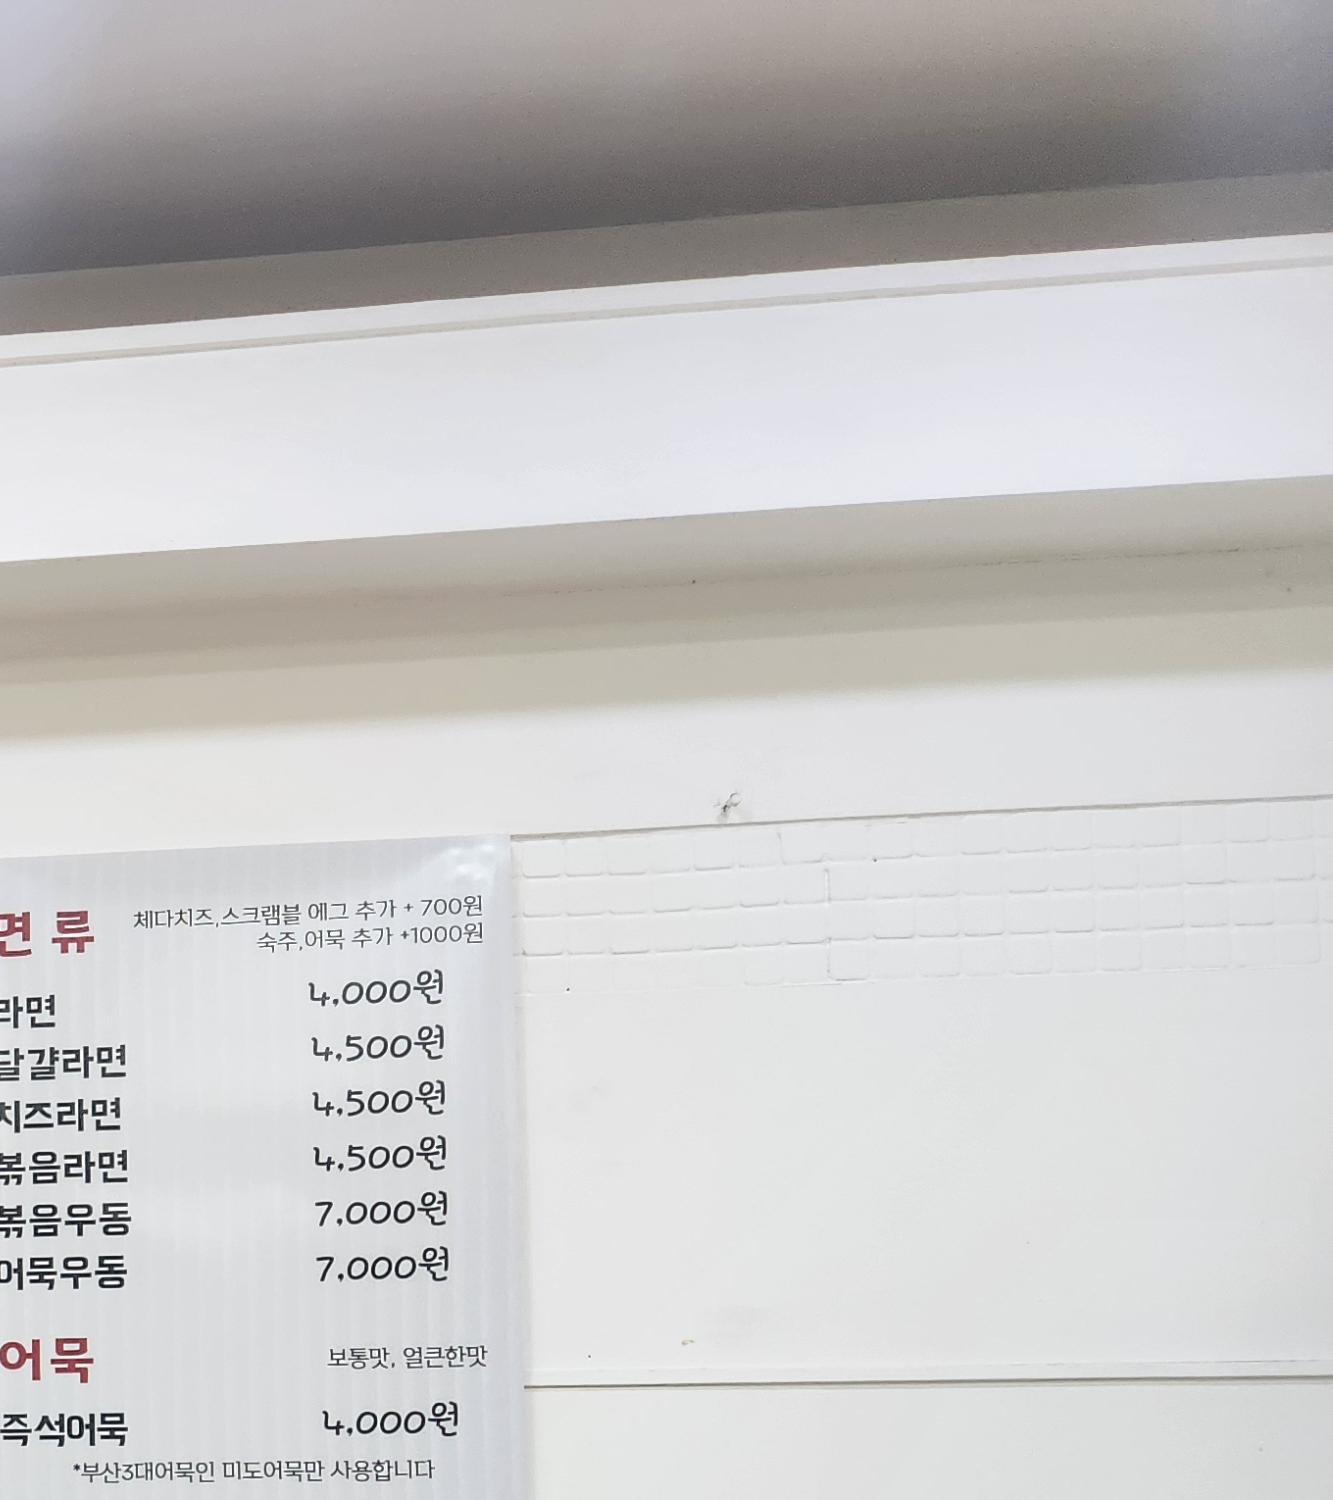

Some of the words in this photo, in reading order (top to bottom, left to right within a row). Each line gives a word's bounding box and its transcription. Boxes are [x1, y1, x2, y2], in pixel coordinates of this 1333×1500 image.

[308, 902, 349, 921] 에그
[355, 899, 397, 921] 추가
[351, 927, 394, 948] 추가
[308, 969, 443, 1007] 4,000원
[311, 1024, 444, 1062] 4,500원
[312, 1079, 445, 1117] 4,500원
[313, 1135, 446, 1172] 4,500원
[315, 1190, 447, 1227] 7,000원
[316, 1246, 449, 1282] 7,000원
[0, 1338, 94, 1384] 어묵
[327, 1347, 395, 1370] 보통맛,
[403, 1345, 488, 1369] 얼큰한맛
[0, 1412, 128, 1447] 즉석어묵
[322, 1401, 458, 1437] 4,000원
[222, 1460, 325, 1482] 미도어묵만
[330, 1459, 435, 1482] 사용합니다
